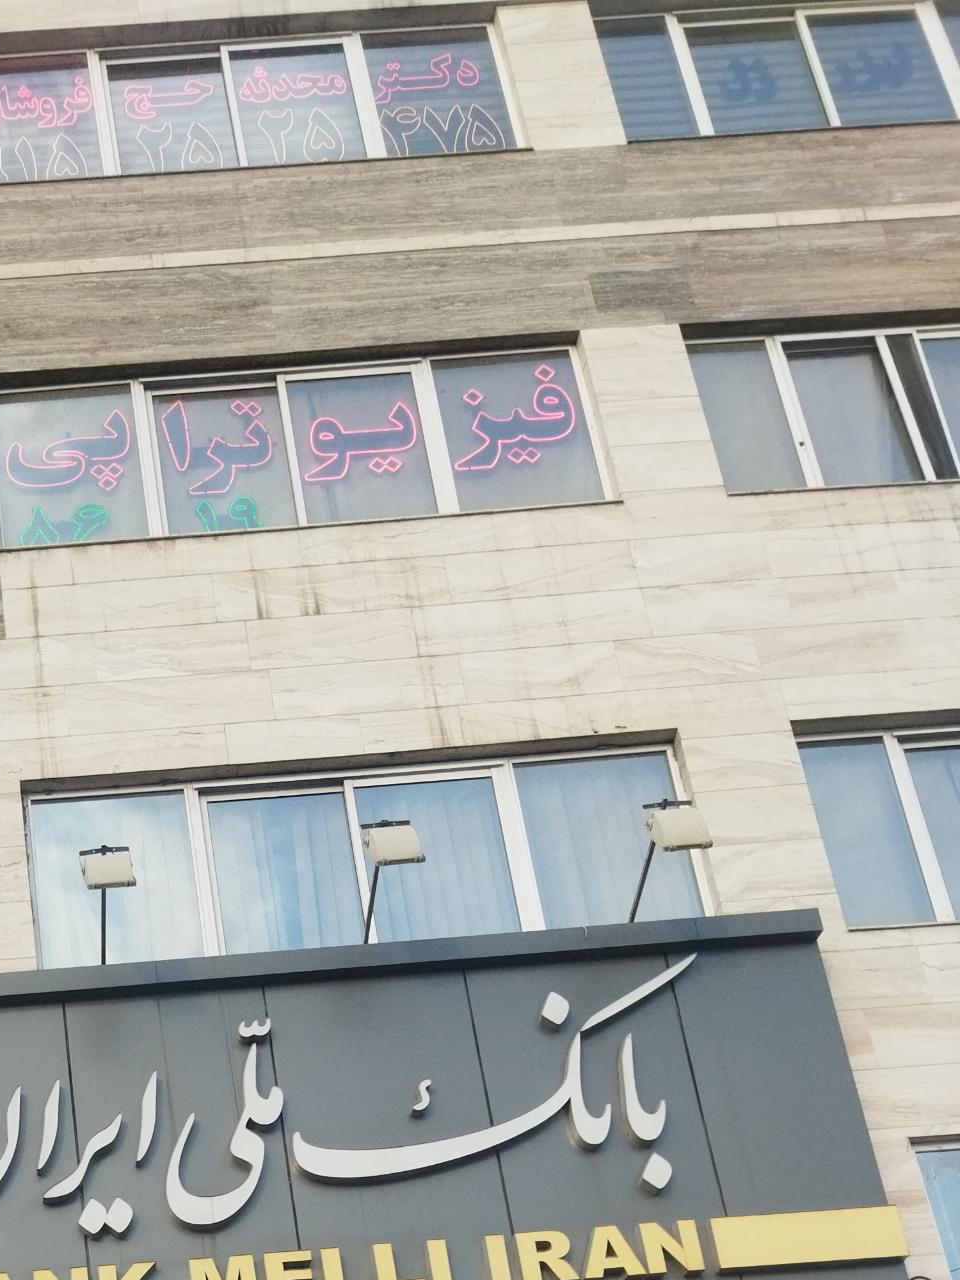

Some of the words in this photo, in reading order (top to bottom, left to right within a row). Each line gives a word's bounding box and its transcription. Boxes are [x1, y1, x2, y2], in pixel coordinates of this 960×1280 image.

[239, 66, 347, 103] محدثه
[375, 52, 479, 105] دکتر
[292, 953, 698, 1192] بانک
